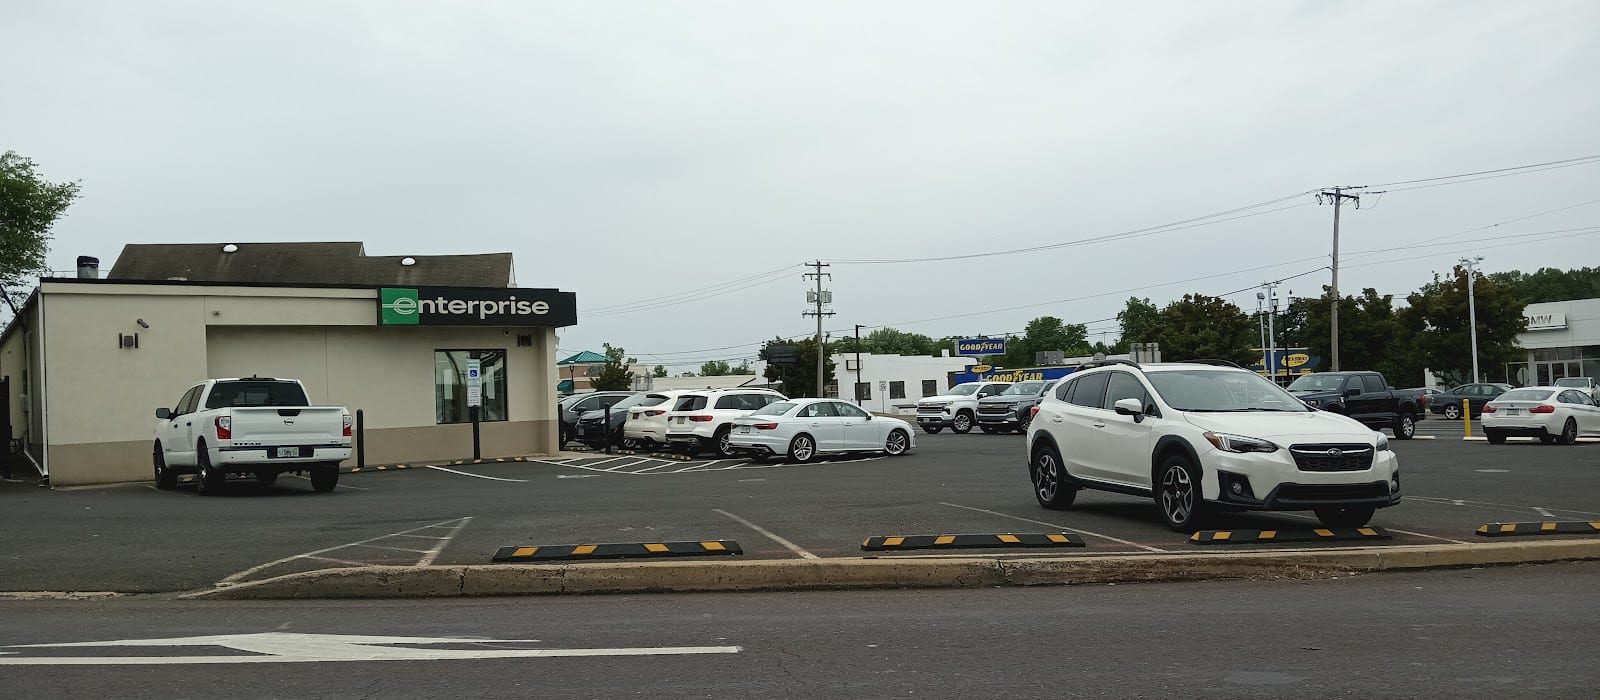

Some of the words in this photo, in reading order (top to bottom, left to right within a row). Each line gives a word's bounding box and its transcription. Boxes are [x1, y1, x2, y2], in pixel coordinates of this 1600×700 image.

[392, 296, 549, 320] enterprise
[960, 342, 1003, 351] GOODYEAR
[986, 371, 1043, 382] GOODYEAR
